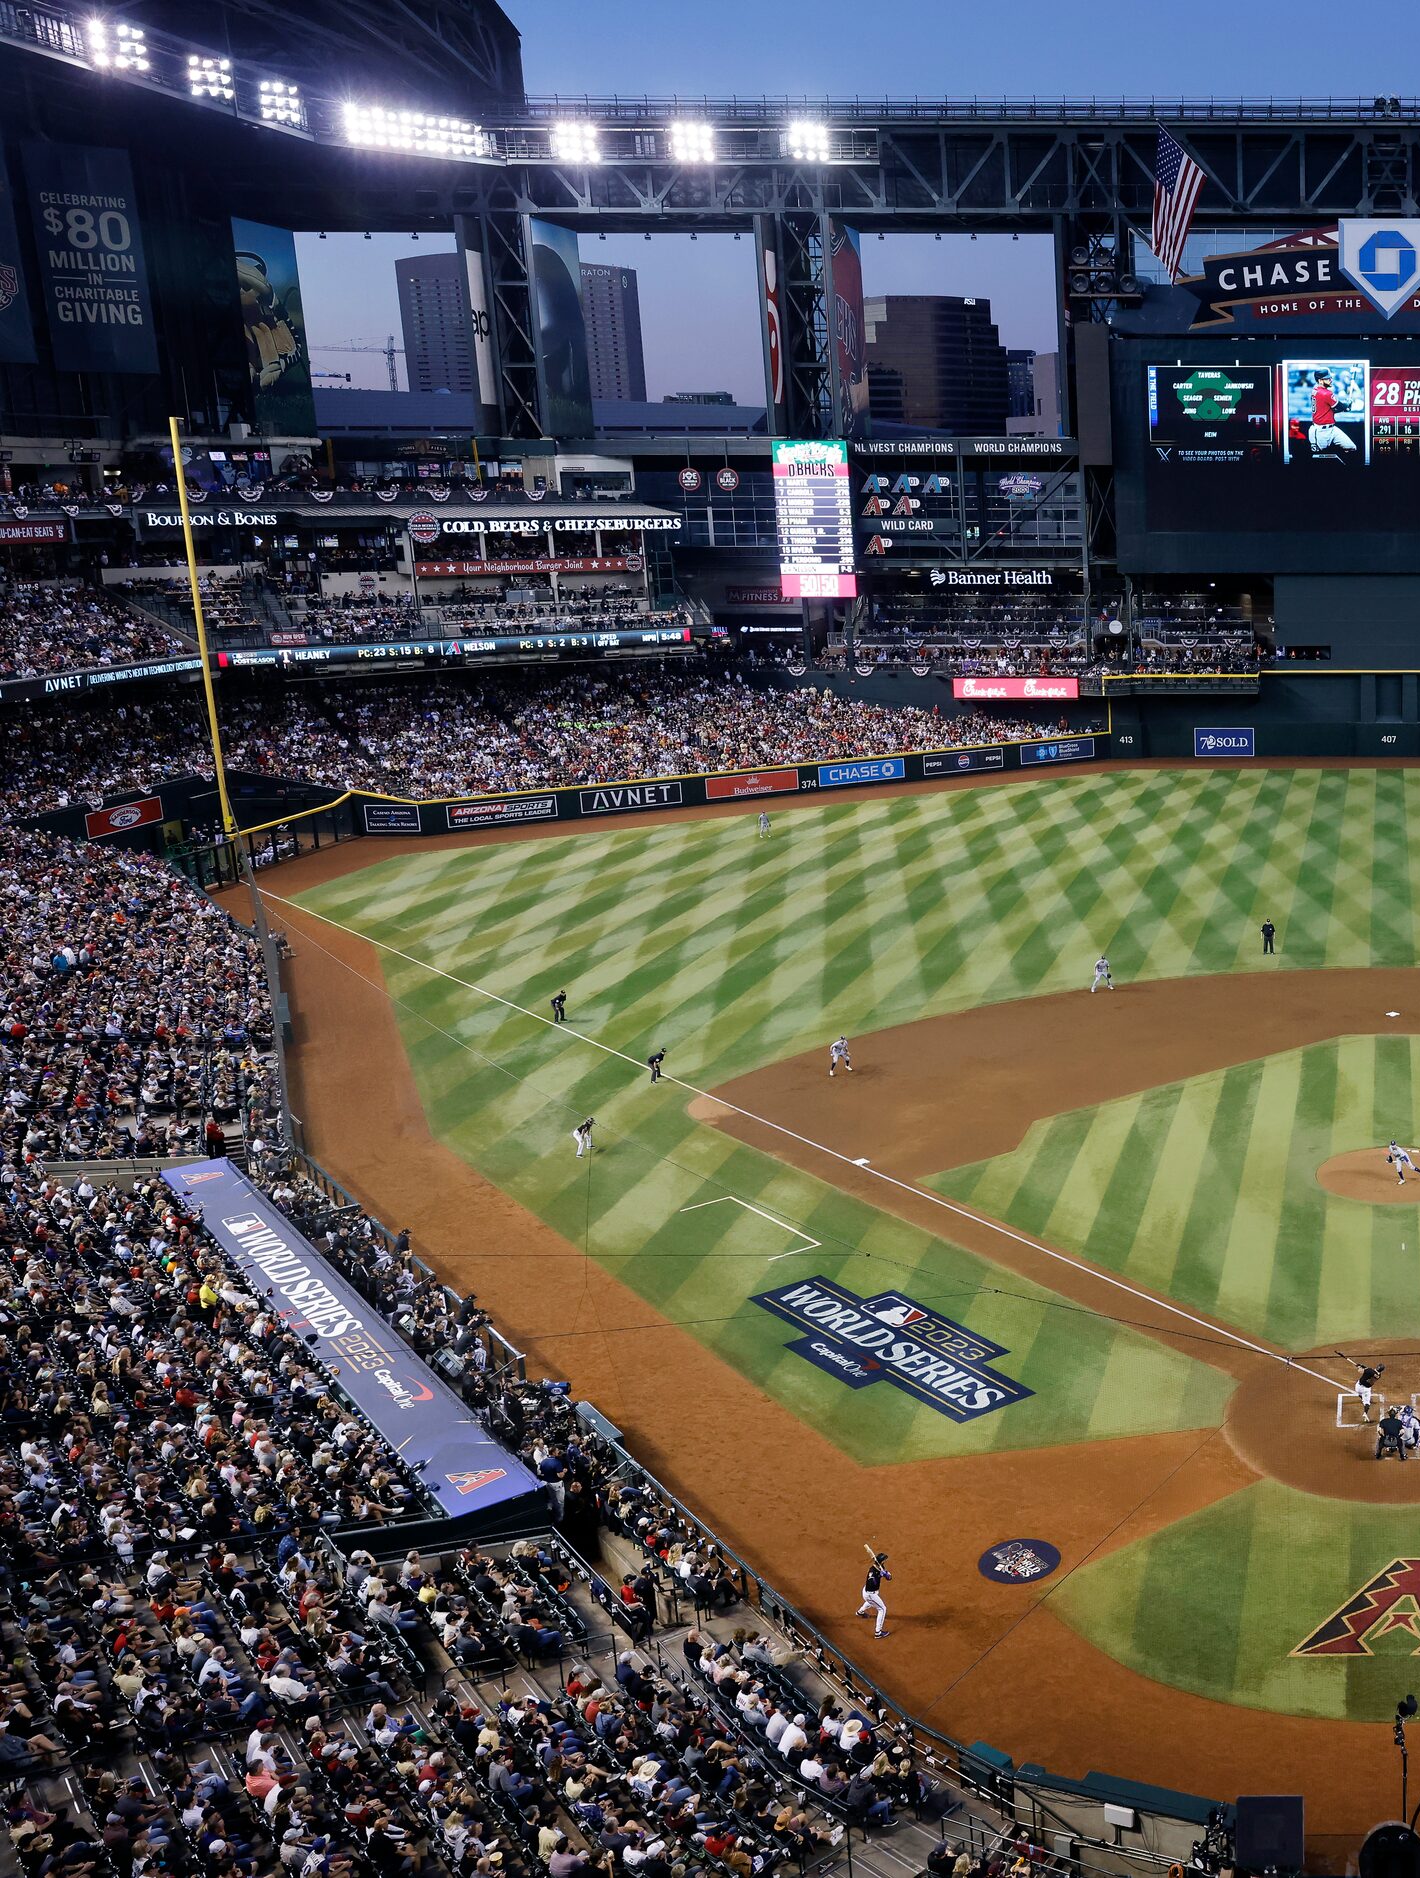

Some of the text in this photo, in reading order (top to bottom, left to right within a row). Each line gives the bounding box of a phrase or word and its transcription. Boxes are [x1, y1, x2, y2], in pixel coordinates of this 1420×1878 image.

[40, 192, 126, 208] CELEBRATING
[43, 206, 131, 252] $80
[49, 250, 136, 272] MILLION
[88, 273, 102, 285] IN
[1218, 260, 1331, 290] CHASE
[54, 286, 140, 302] CHARITABLE
[58, 302, 143, 325] GIVING
[1260, 302, 1298, 314] HOME
[1309, 300, 1325, 310] OF
[1336, 300, 1362, 308] THE
[1374, 382, 1400, 405] 28
[1377, 425, 1391, 434] .291
[854, 444, 866, 452] NL
[869, 444, 895, 452] WEST
[899, 444, 954, 452] CHAMPIONS
[974, 444, 1062, 453] WORLD CHAMPIONS
[999, 476, 1042, 487] World Champions
[218, 512, 231, 525] &
[488, 520, 540, 532] BEERS
[543, 521, 552, 531] &
[555, 518, 682, 531] CHEESEBURGERS
[881, 520, 934, 530] WILD CARD
[463, 560, 583, 574] Your Neighborhood Burger Joint
[949, 570, 1052, 585] Banner Health
[742, 592, 779, 601] FITNESS
[295, 650, 331, 660] HEANEY
[358, 649, 373, 658] PC:
[373, 647, 386, 656] 23
[389, 648, 398, 656] S:
[400, 646, 411, 655] 15
[428, 645, 434, 654] 8
[464, 642, 496, 652] NELSON
[520, 640, 534, 649] PC:
[537, 640, 543, 648] 5
[560, 639, 565, 647] 2
[90, 671, 116, 684] DELIVERING
[115, 669, 132, 681] WHAT'S
[132, 668, 143, 678] NEXT
[148, 663, 176, 675] TECHNOLOGY
[45, 676, 82, 692] AVNET
[1381, 734, 1397, 744] 407
[830, 766, 879, 781] CHASE
[734, 785, 773, 795] Budweiser
[802, 780, 816, 788] 374
[592, 786, 671, 809] AVNET
[454, 801, 549, 816] ARIZONA SPORTS
[237, 1230, 386, 1371] WORLD SERIES 2023
[780, 1284, 1006, 1410] WORLD SERIES
[908, 1321, 986, 1362] 2023
